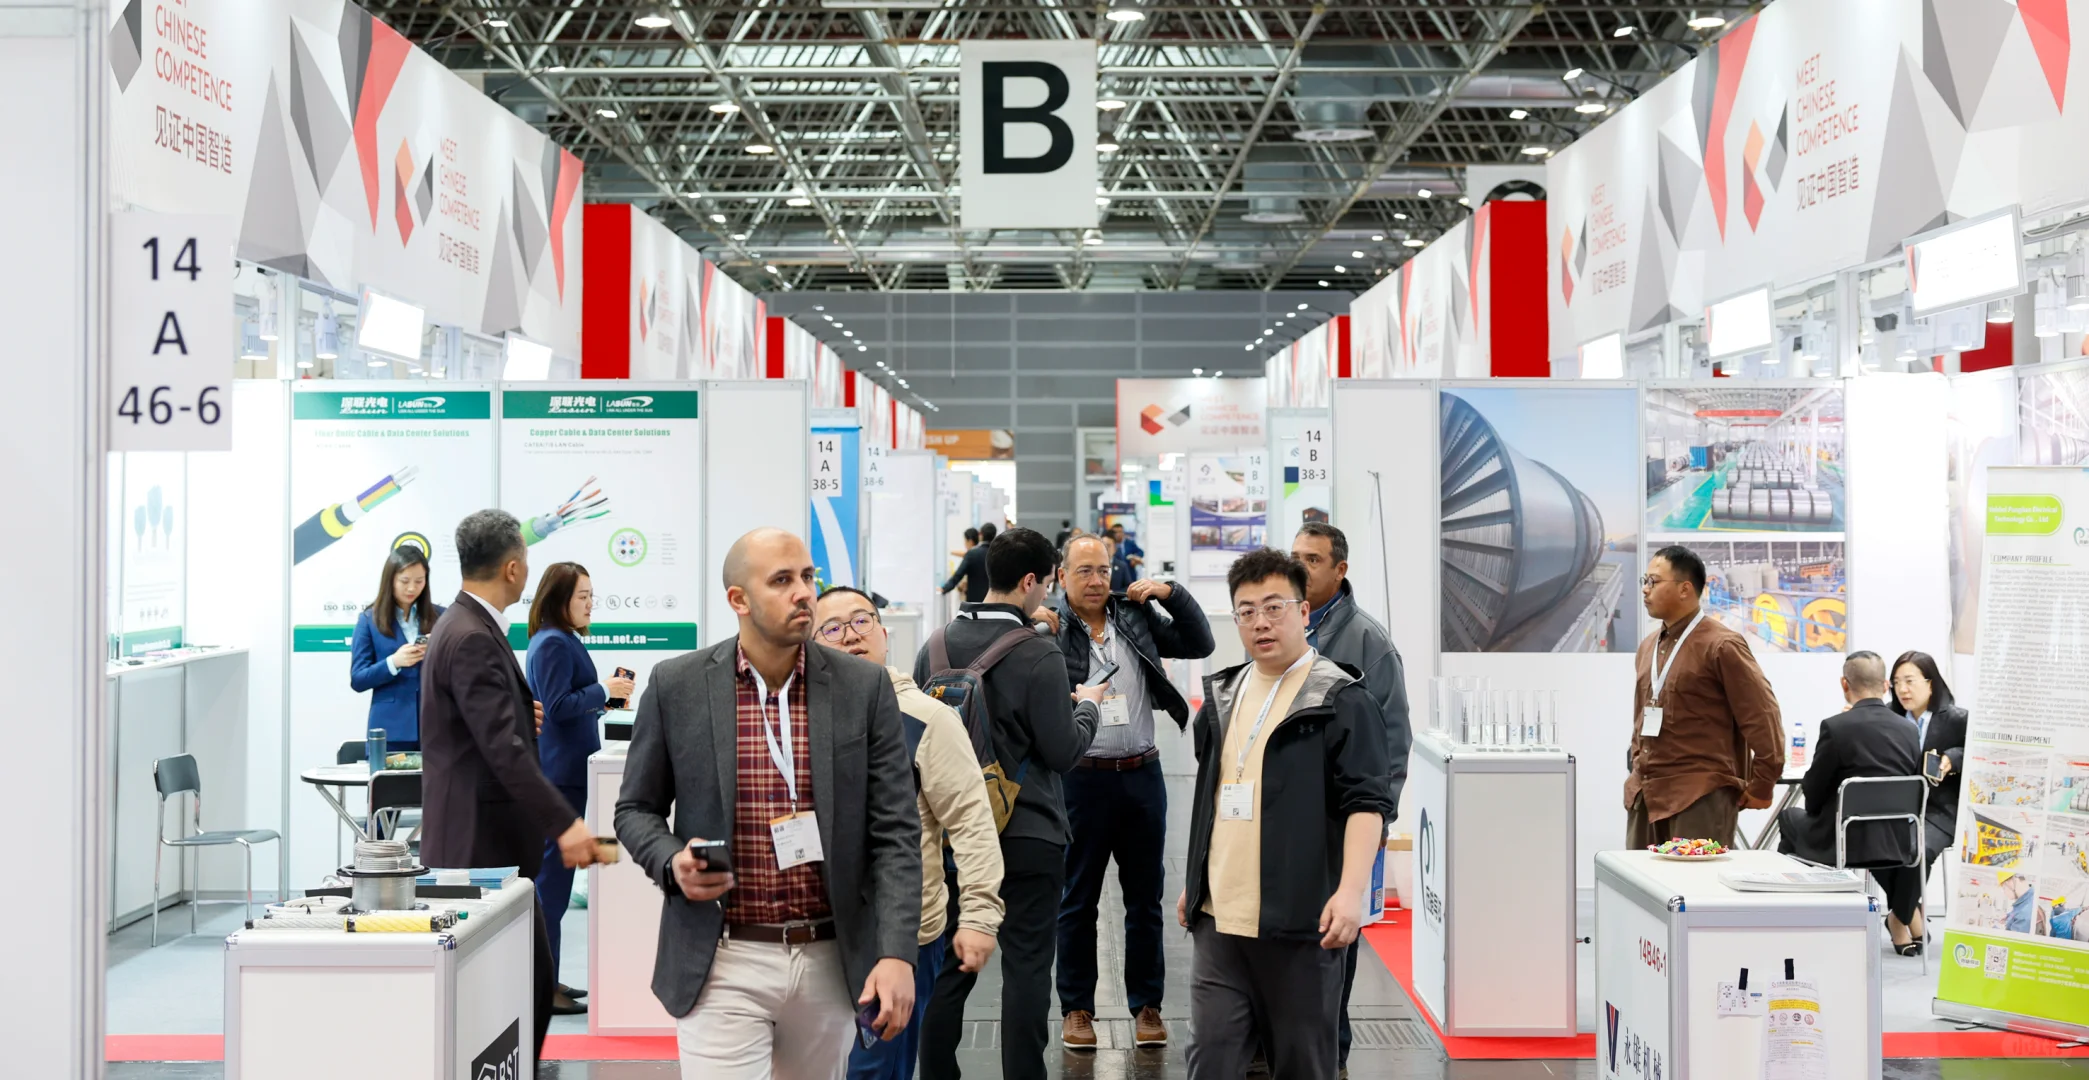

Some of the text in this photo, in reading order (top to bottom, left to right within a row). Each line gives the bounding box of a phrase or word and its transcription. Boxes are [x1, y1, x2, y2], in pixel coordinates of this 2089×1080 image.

[156, 4, 206, 59] CHINESE
[155, 47, 232, 112] COMPETENCE
[1796, 53, 1820, 90] MEET
[1796, 80, 1836, 123] CHINESE
[982, 61, 1074, 174] B
[155, 105, 232, 174] 见证中国智造
[1796, 104, 1858, 156] COMPETENCE
[440, 136, 456, 162] MEET
[440, 164, 466, 196] CHINESE
[1797, 154, 1859, 212] 见证中国智造
[440, 193, 479, 231] COMPETENCE
[143, 237, 201, 281] 14
[152, 311, 188, 355] A
[118, 385, 221, 425] 46-6
[406, 429, 431, 437] Center
[433, 429, 470, 437] Solutions
[530, 428, 557, 438] Copper
[558, 428, 581, 437] Cable
[589, 428, 606, 437] Data
[607, 428, 633, 437] Center
[634, 428, 671, 437] Solutions
[1306, 430, 1322, 443] 14
[818, 440, 833, 453] 14
[868, 447, 880, 456] 14
[1310, 449, 1318, 461] B
[820, 460, 830, 472] A
[870, 462, 878, 472] A
[1250, 456, 1261, 465] 14
[1252, 470, 1258, 480] B
[1301, 469, 1326, 480] 38-3
[812, 479, 839, 490] 38-5
[1246, 486, 1265, 495] 38-2
[1993, 555, 2053, 563] COMPANY PROFILE
[2014, 734, 2052, 745] EQUIPMENT
[1639, 936, 1667, 977] 14B46-1
